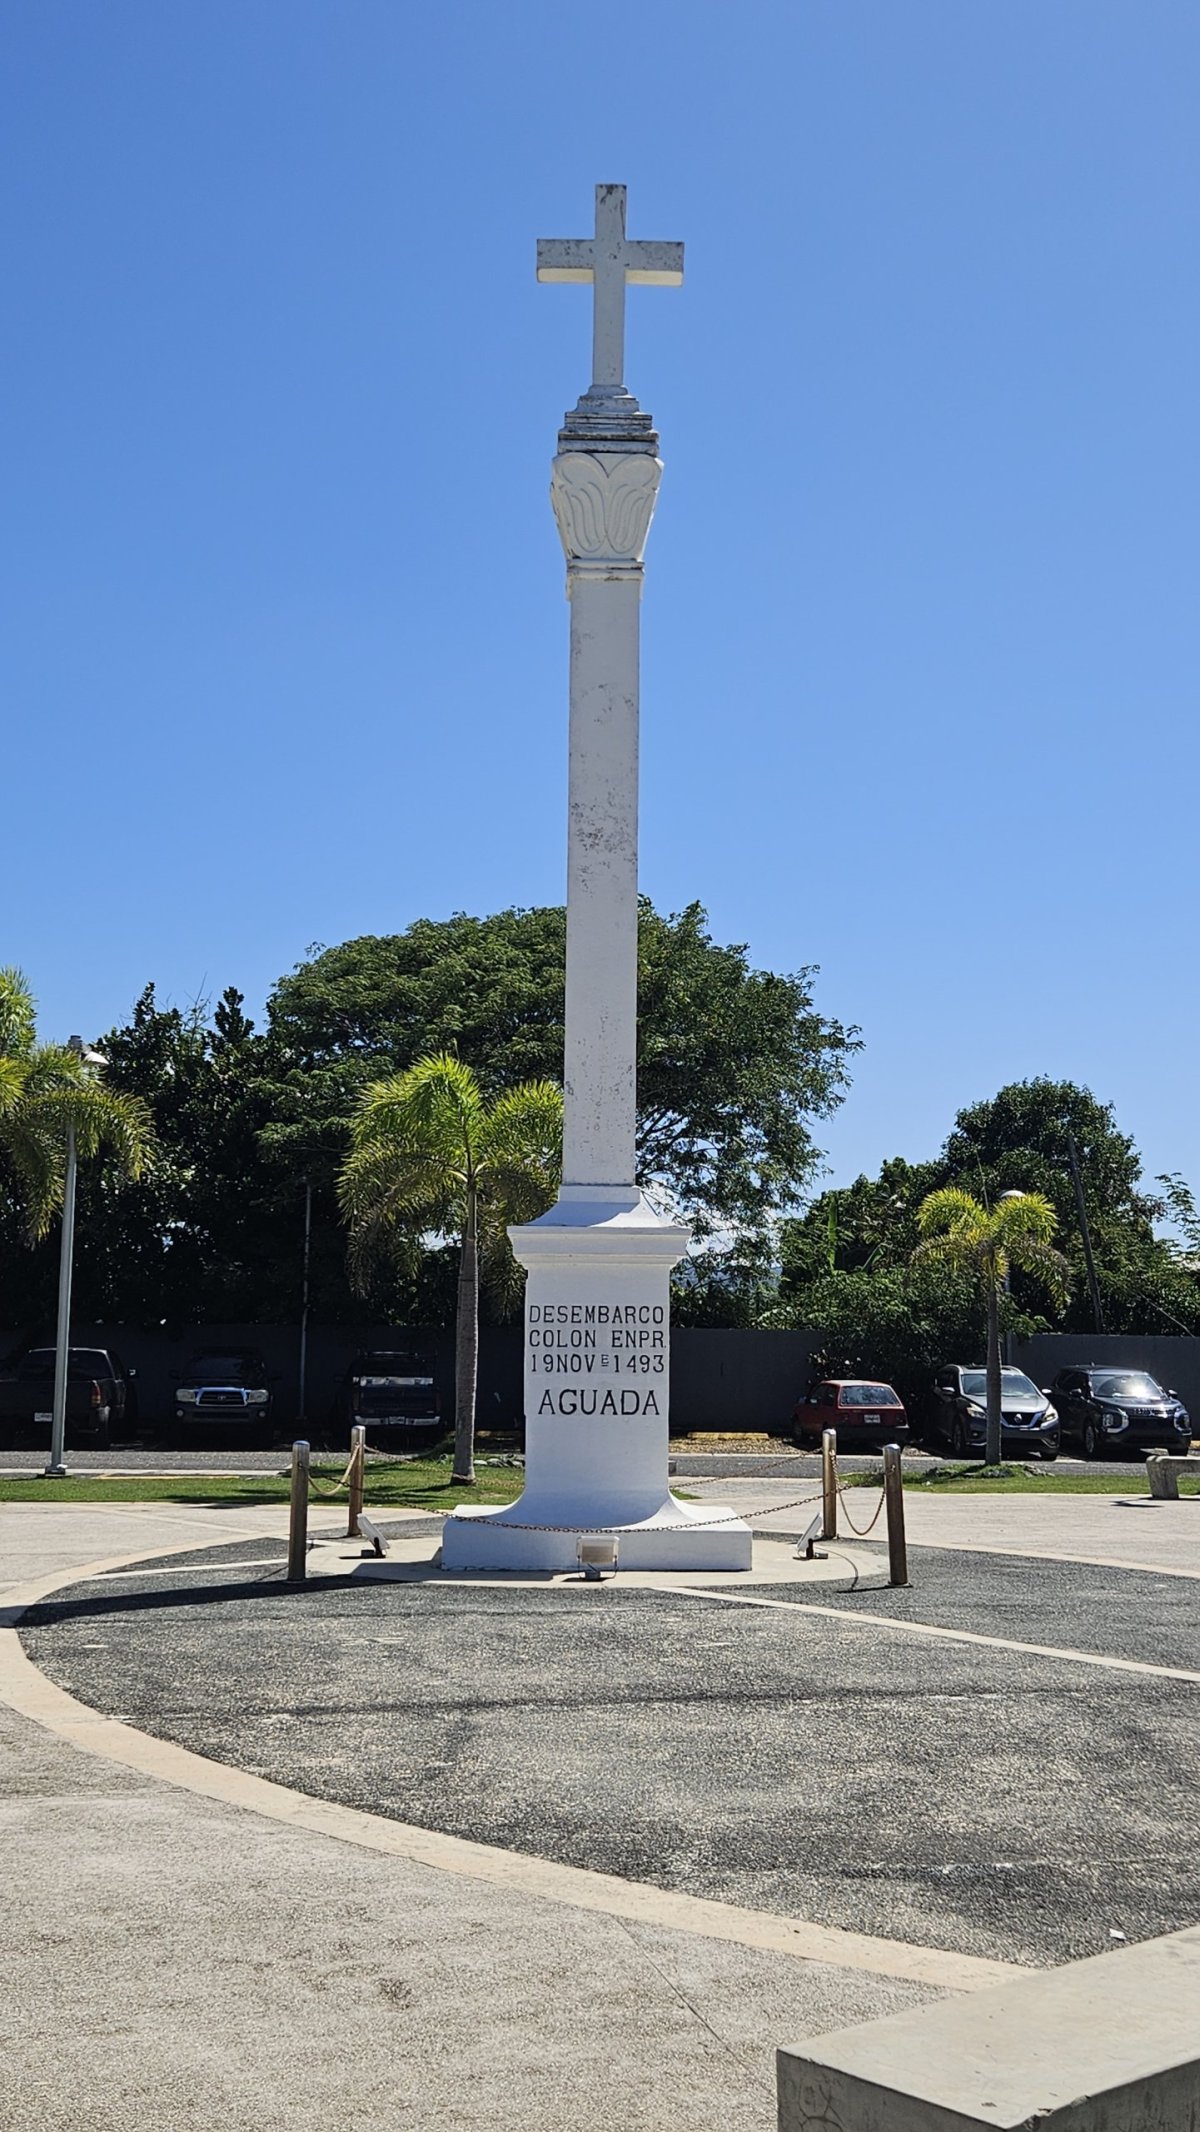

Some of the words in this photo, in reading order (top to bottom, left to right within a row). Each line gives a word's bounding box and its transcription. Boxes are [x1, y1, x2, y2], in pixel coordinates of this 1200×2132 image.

[529, 1305, 664, 1324] DESEMBARCO
[529, 1330, 596, 1348] COLON
[538, 1388, 660, 1415] AGUADA
